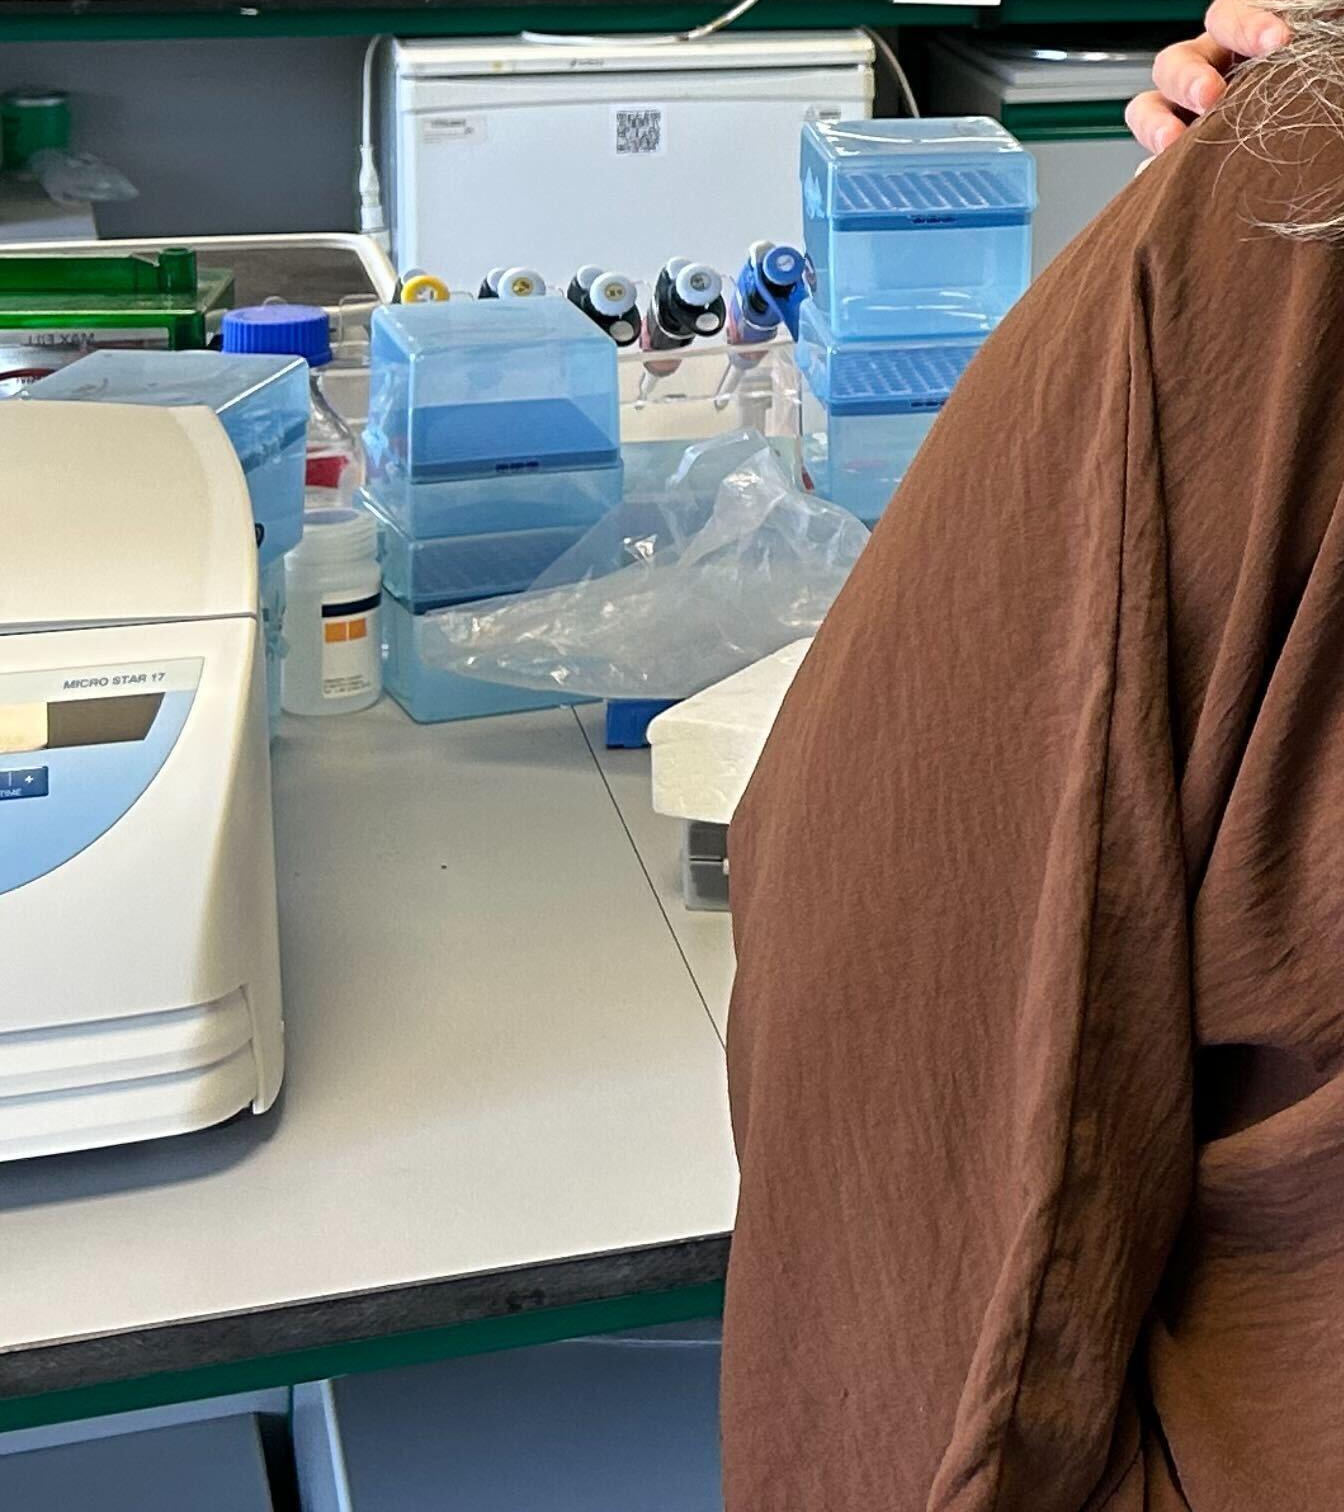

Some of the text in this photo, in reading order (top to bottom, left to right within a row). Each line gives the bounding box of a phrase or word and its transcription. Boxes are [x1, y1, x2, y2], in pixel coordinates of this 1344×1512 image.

[63, 672, 166, 690] MICRO STAR 17
